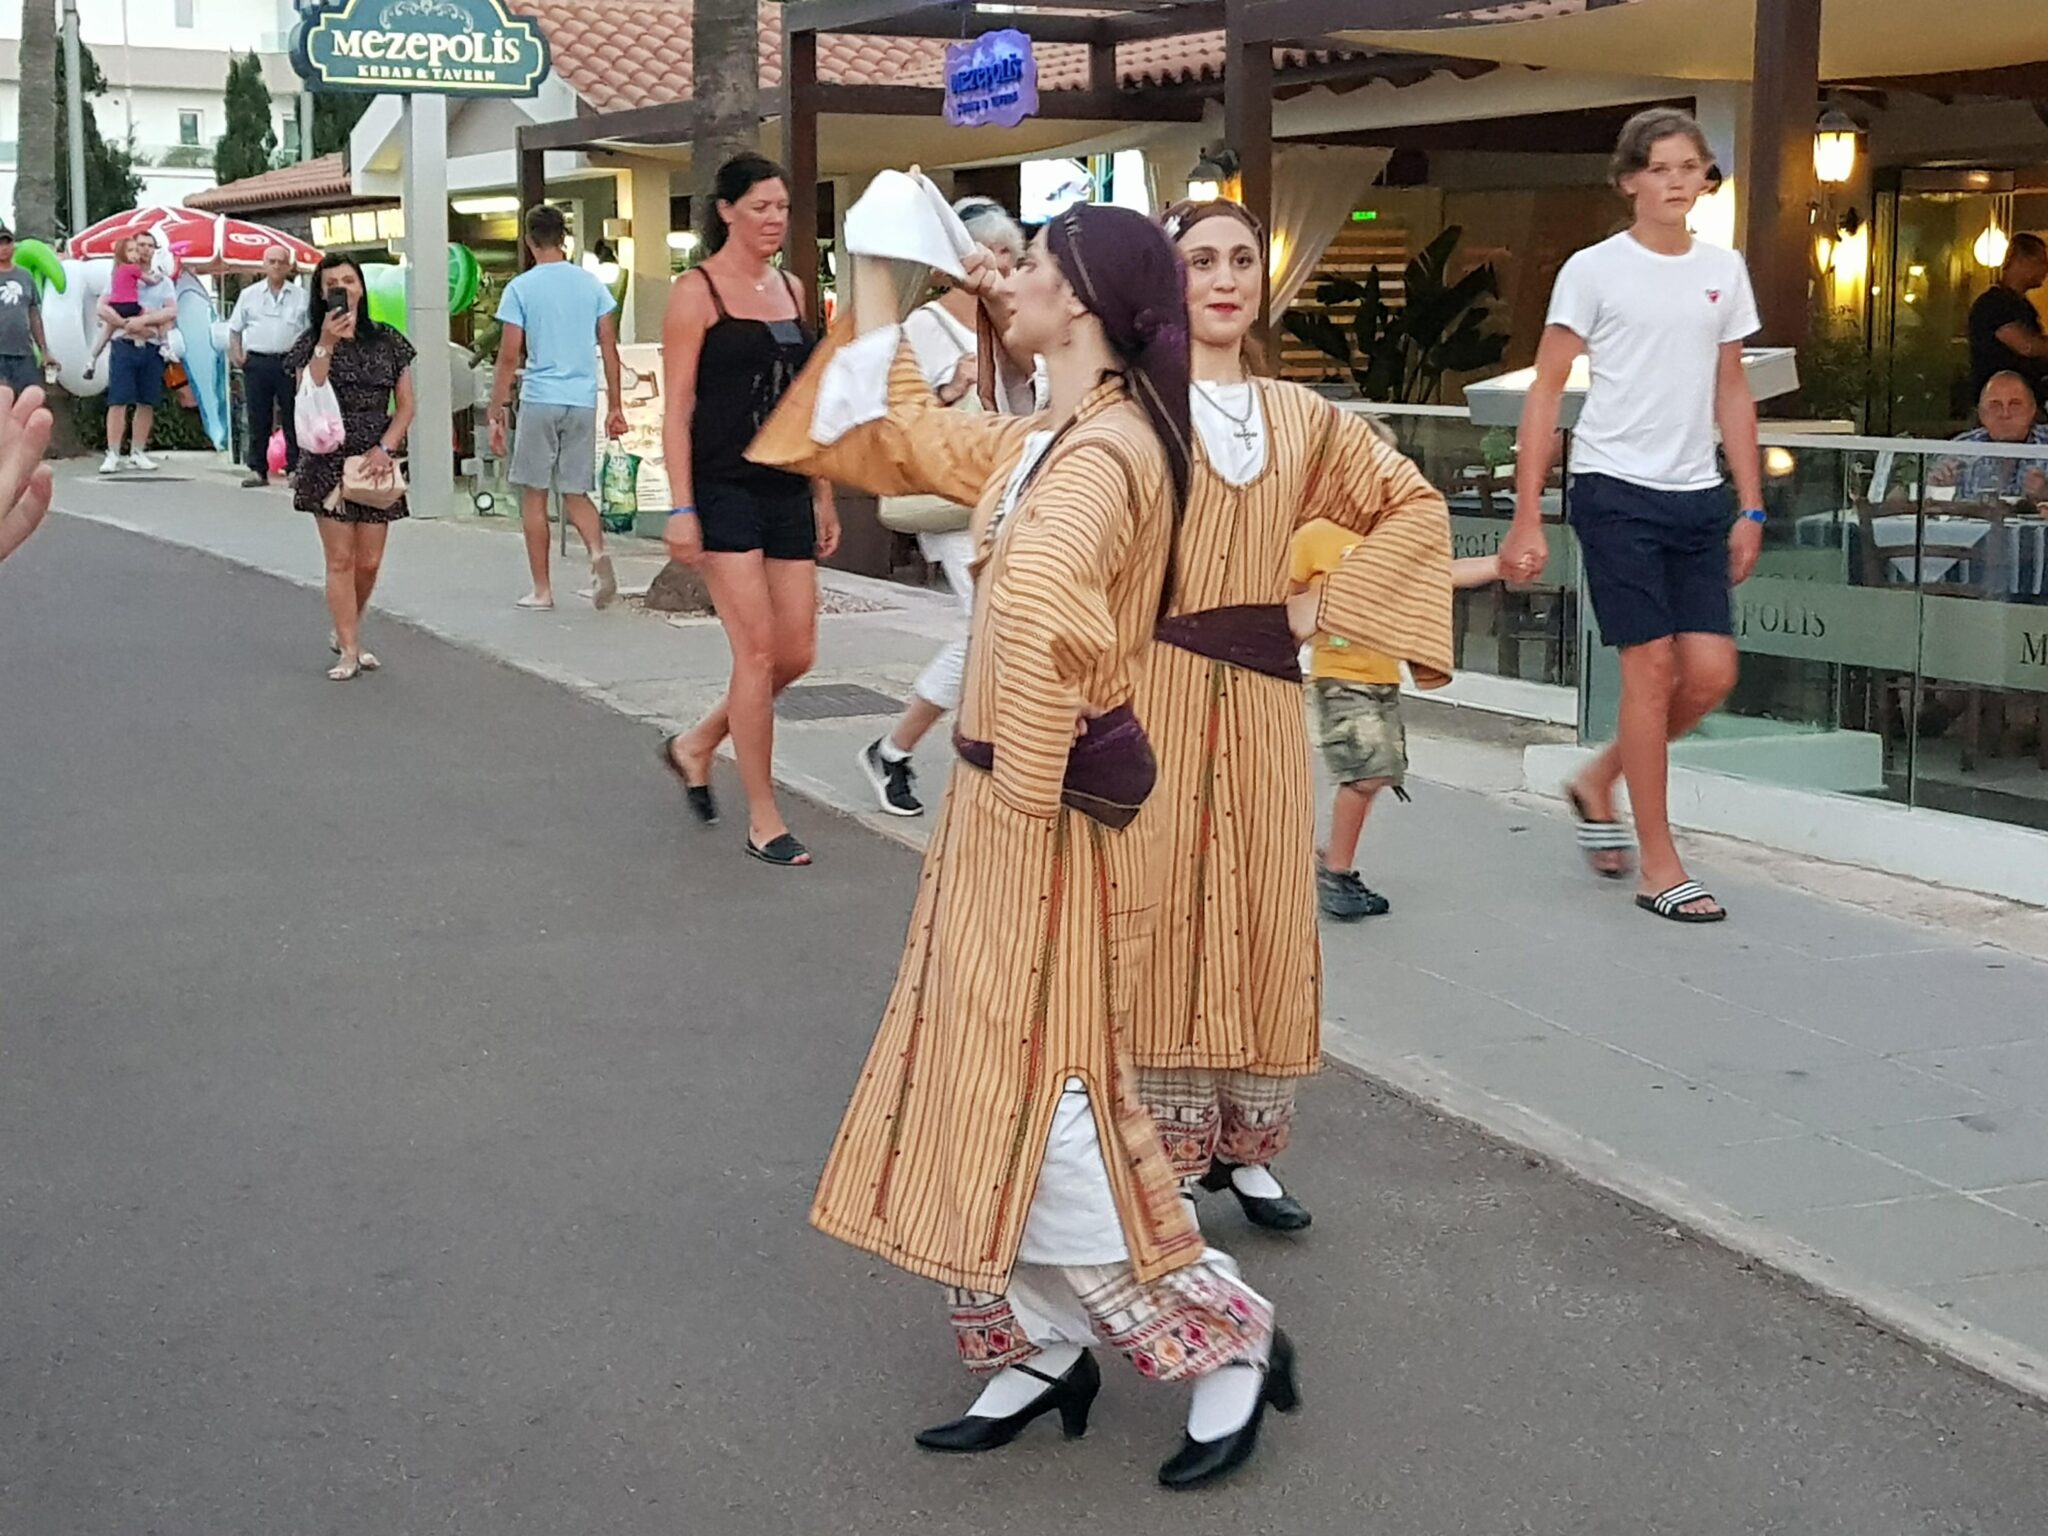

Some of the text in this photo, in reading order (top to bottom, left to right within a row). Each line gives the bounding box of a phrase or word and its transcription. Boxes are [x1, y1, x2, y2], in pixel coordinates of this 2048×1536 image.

[357, 65, 496, 82] KEBAB & TAVERN
[2019, 631, 2048, 666] M
